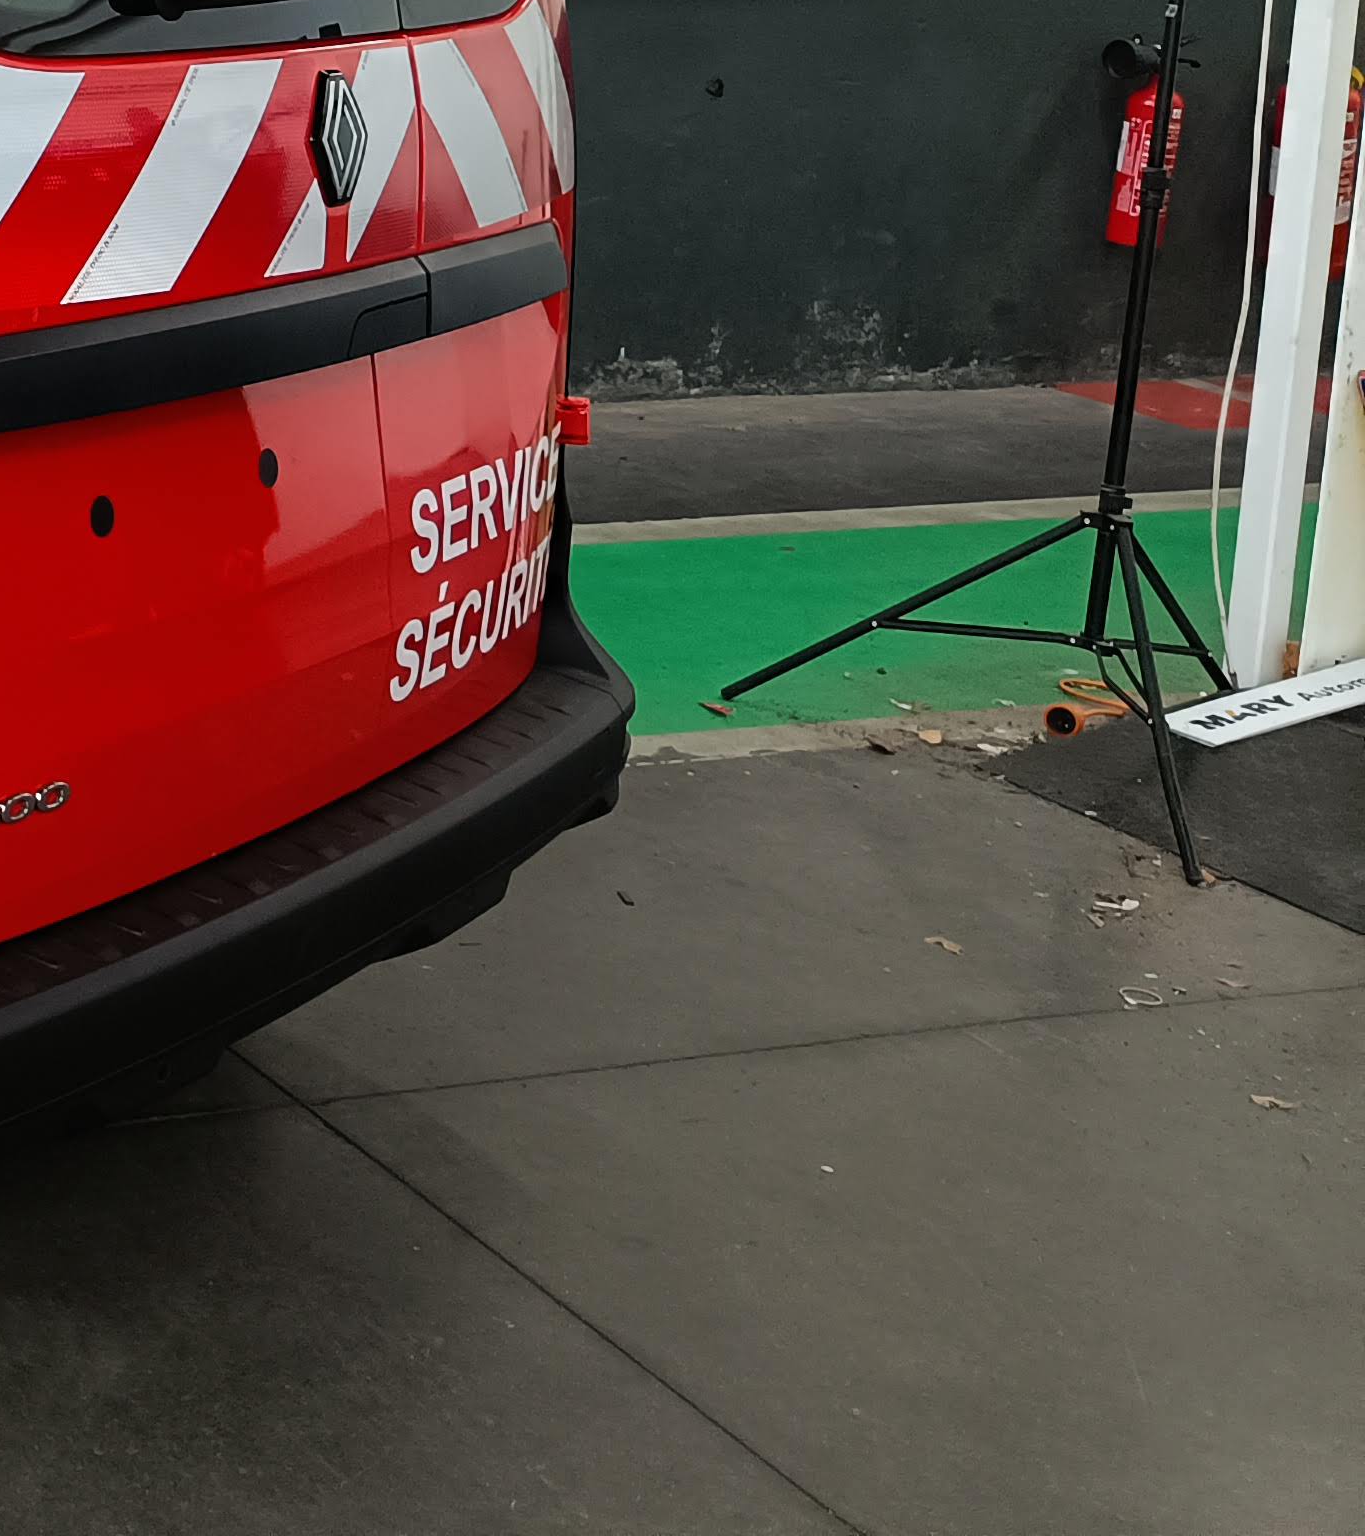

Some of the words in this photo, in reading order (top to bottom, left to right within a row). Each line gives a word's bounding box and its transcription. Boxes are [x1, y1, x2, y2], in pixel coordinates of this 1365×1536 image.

[410, 421, 562, 574] SERVICE
[390, 534, 553, 703] SÉCURIT
[1189, 695, 1295, 730] MARY
